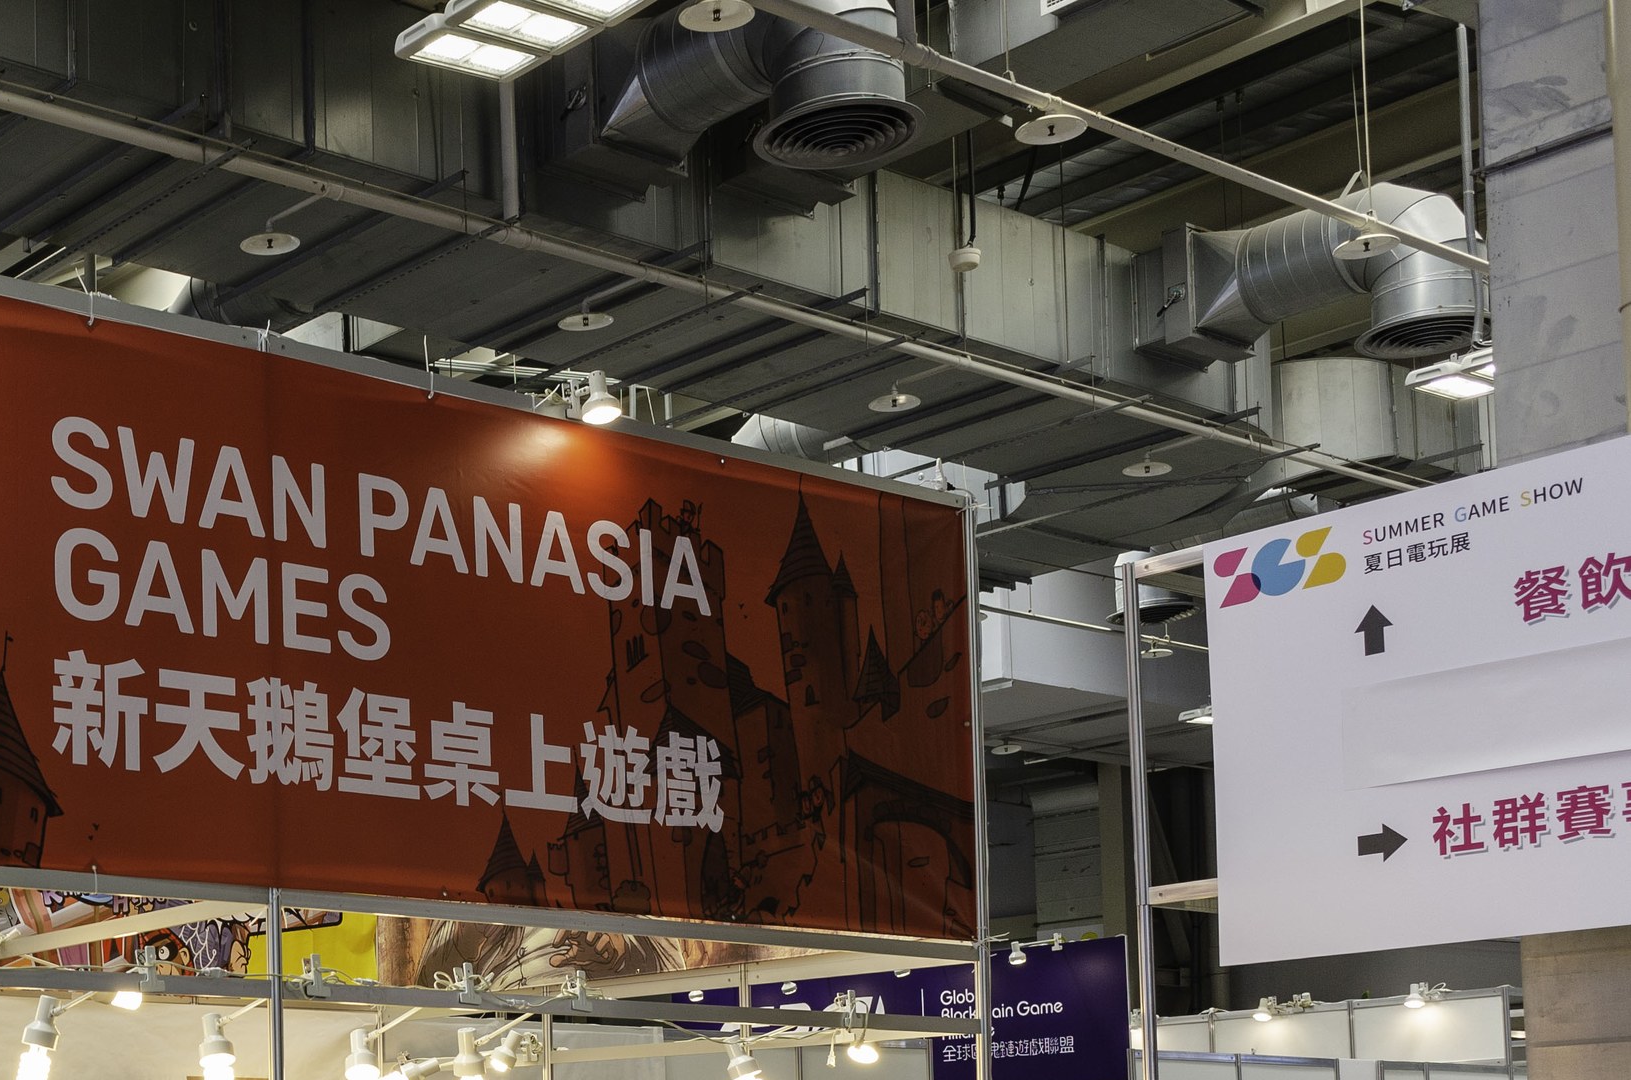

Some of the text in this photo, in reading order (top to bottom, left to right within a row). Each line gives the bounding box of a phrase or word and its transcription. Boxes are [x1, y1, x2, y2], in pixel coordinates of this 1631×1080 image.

[50, 416, 713, 617] SWAN PANASIA
[1362, 477, 1584, 546] SUMMER GAME SHOW
[1363, 531, 1471, 575] 夏日電玩展
[1514, 552, 1631, 625] 餐飲
[53, 527, 392, 661] GAMES
[51, 649, 725, 833] 新天鵝堡桌上遊戲
[1432, 781, 1631, 857] 社群賽
[940, 989, 975, 1006] Glob
[941, 1000, 1063, 1019] Blockain Game
